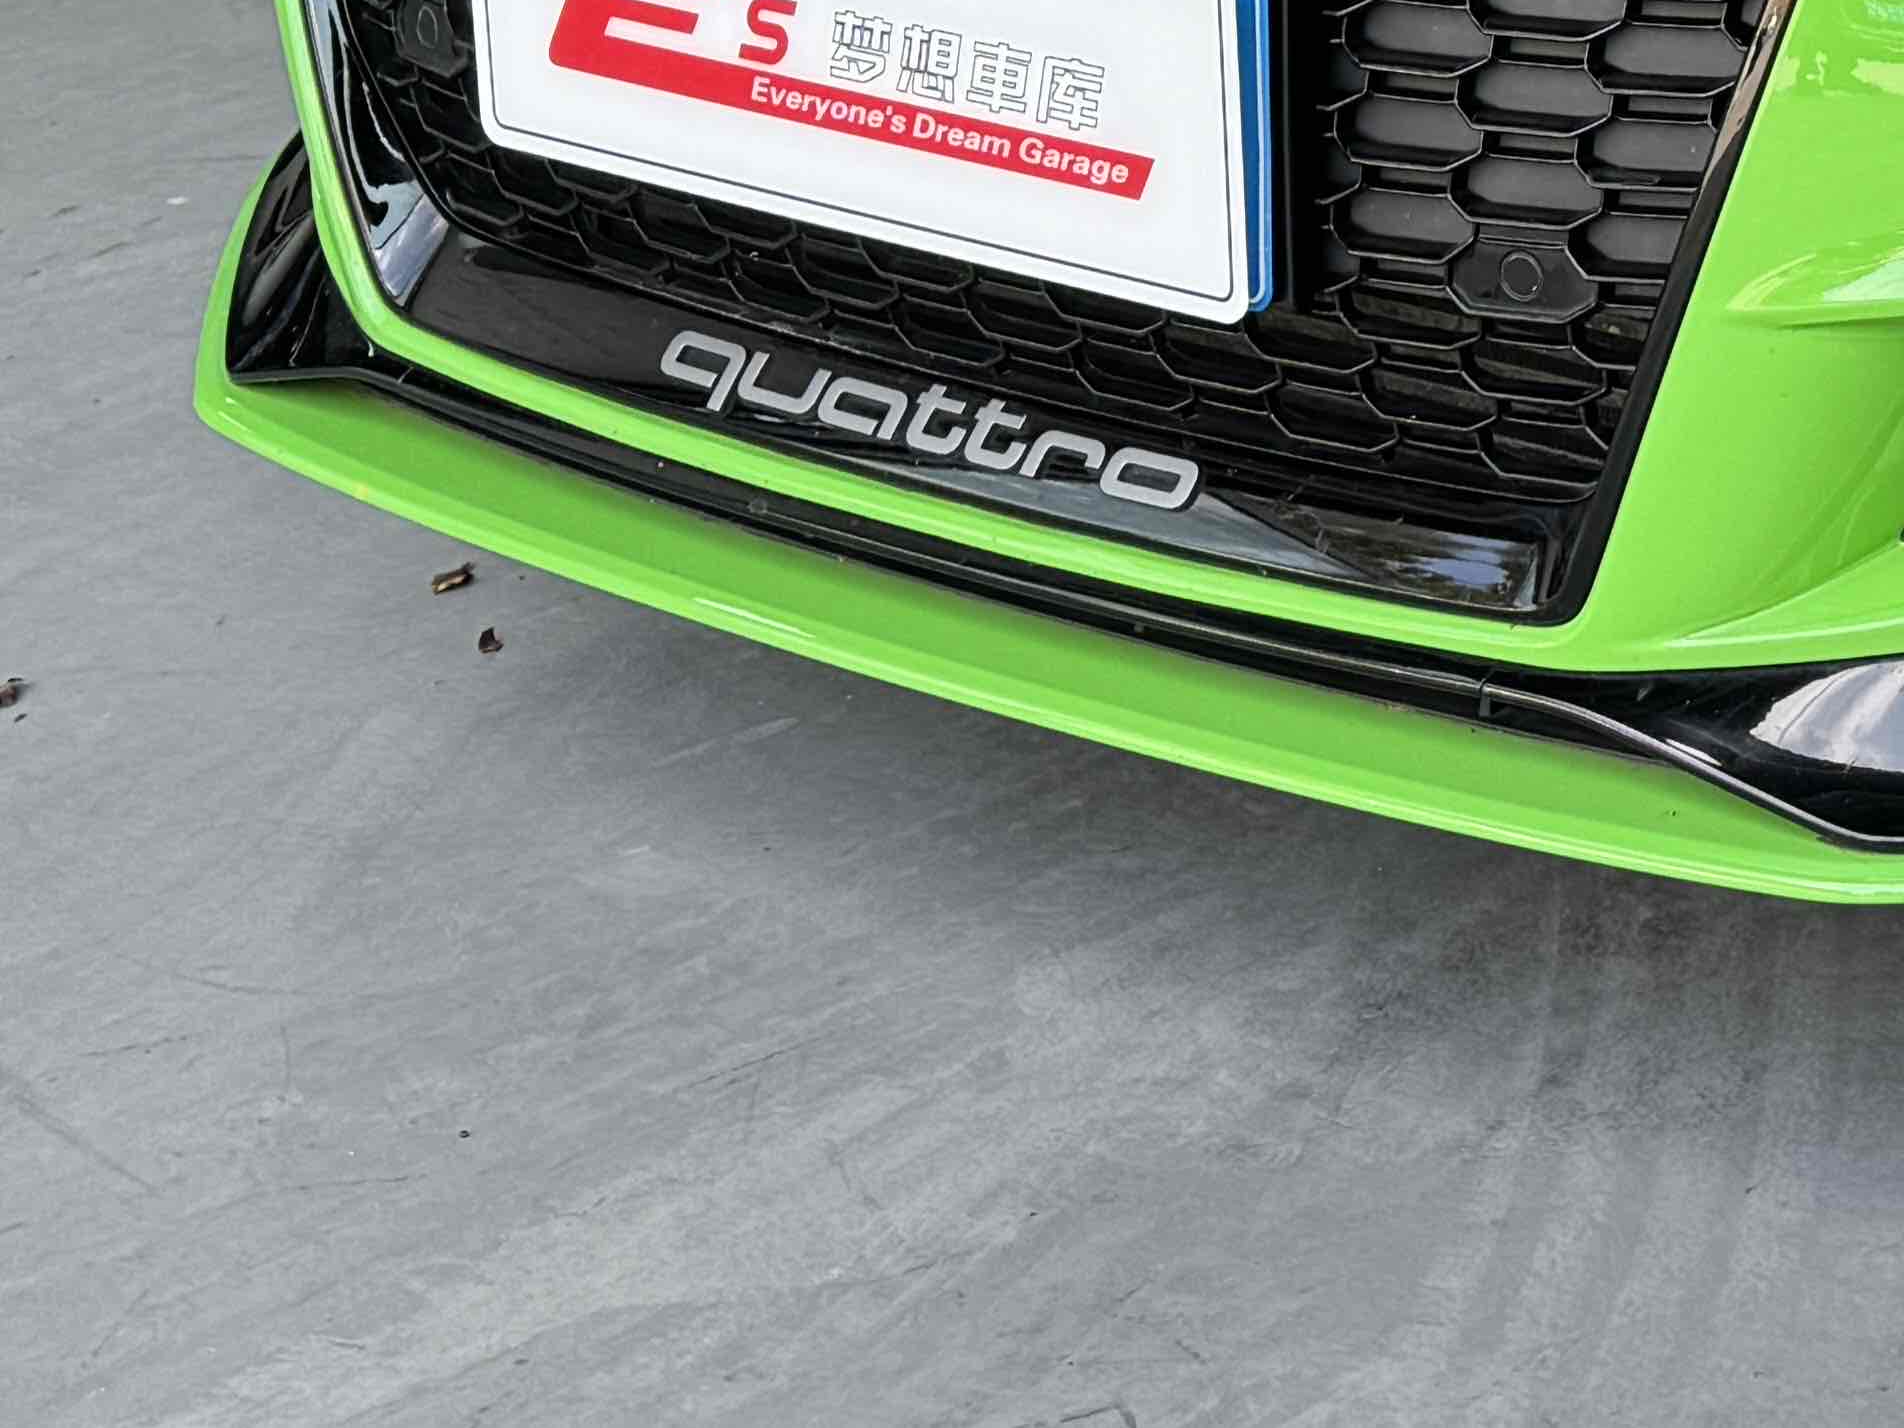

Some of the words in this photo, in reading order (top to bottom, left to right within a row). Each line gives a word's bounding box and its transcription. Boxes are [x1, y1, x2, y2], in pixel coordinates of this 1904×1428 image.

[750, 76, 906, 134] Everyone's
[912, 115, 1011, 159] Dream
[1018, 137, 1129, 185] Garage
[829, 10, 1105, 131] 梦想車库
[660, 330, 1199, 510] quattro
